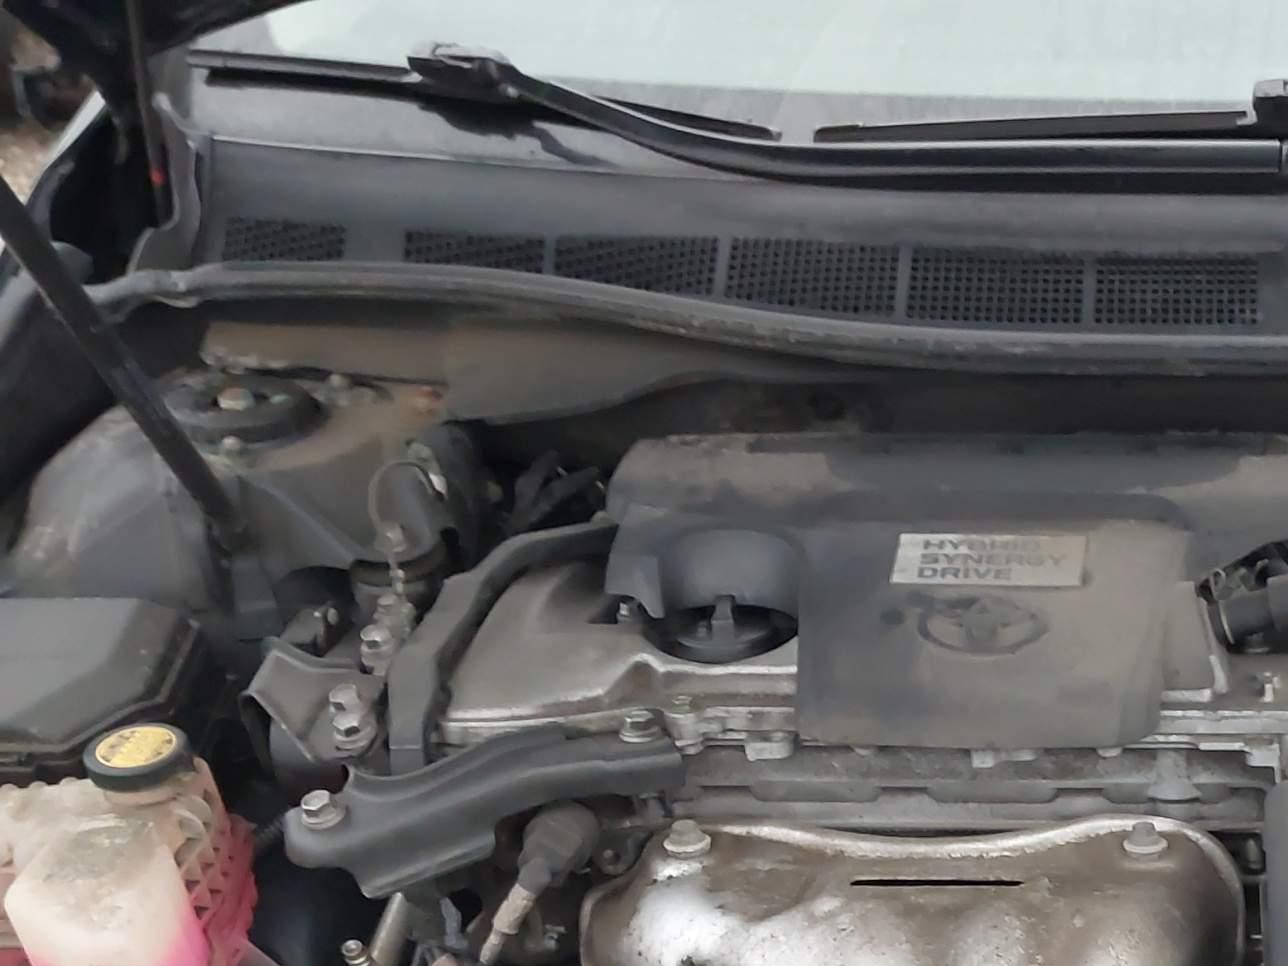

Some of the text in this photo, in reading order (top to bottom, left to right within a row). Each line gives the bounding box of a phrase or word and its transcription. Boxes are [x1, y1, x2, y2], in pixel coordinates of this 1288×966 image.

[922, 538, 1041, 552] HYBRID
[919, 552, 1068, 567] SYNERGY
[916, 566, 1013, 580] DRIVE
